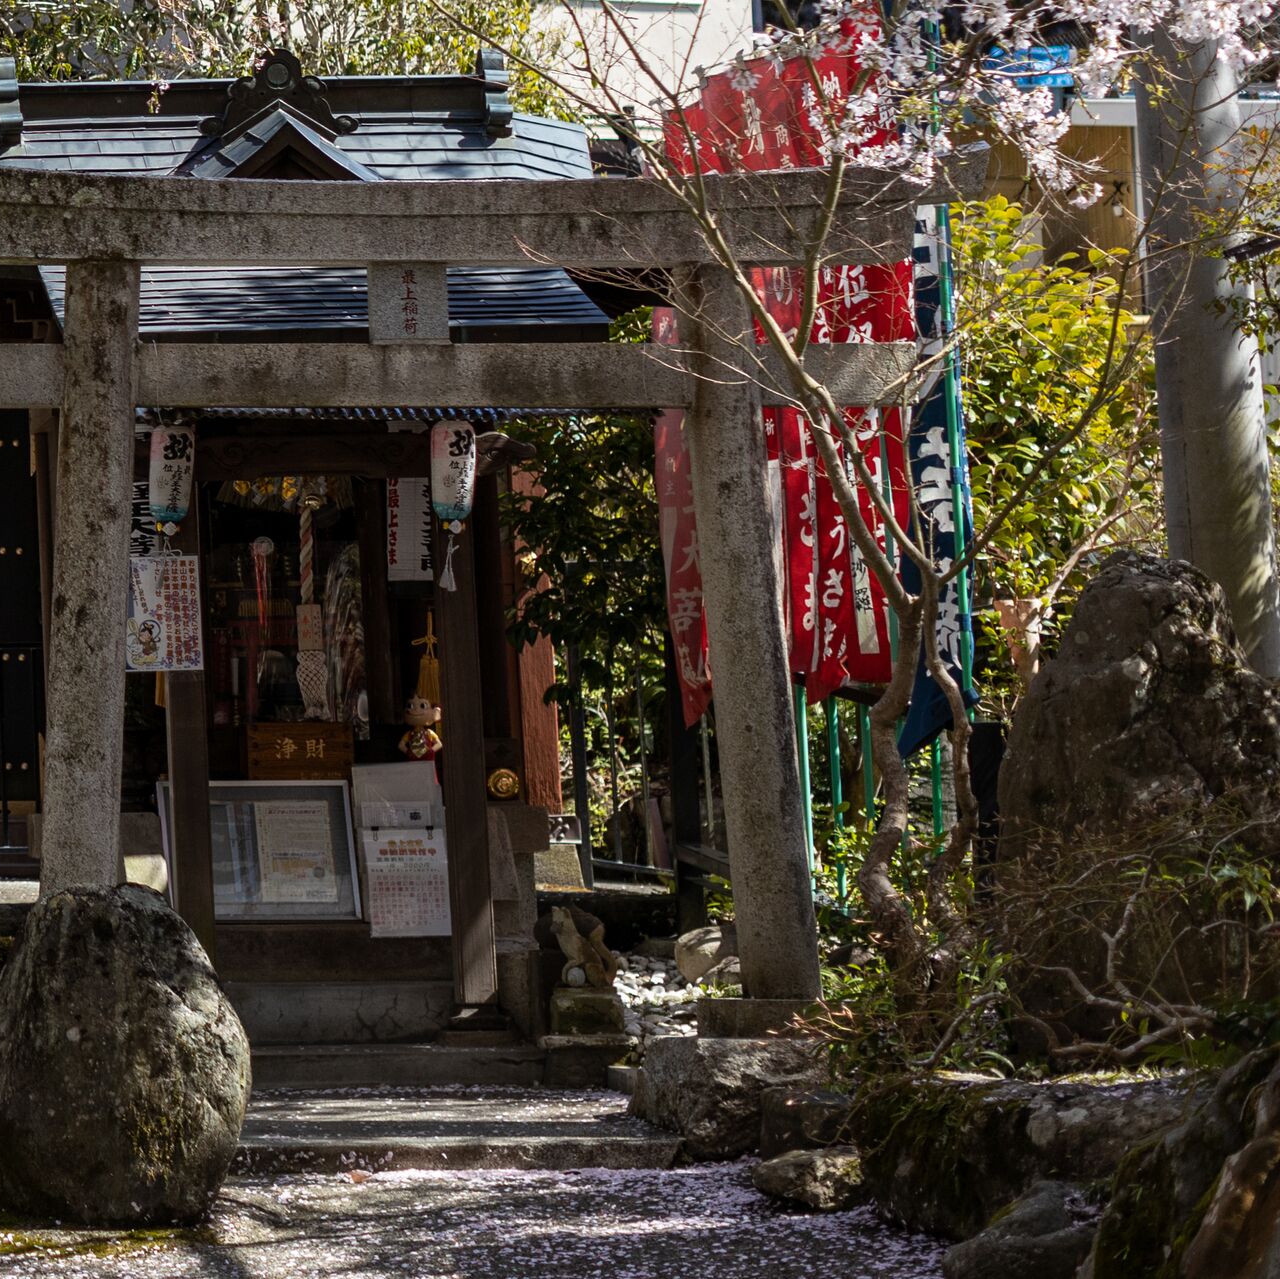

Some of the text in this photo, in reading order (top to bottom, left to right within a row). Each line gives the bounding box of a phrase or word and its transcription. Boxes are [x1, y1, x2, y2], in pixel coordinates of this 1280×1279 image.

[401, 270, 417, 335] 最上稲荷
[274, 737, 327, 759] 浄財
